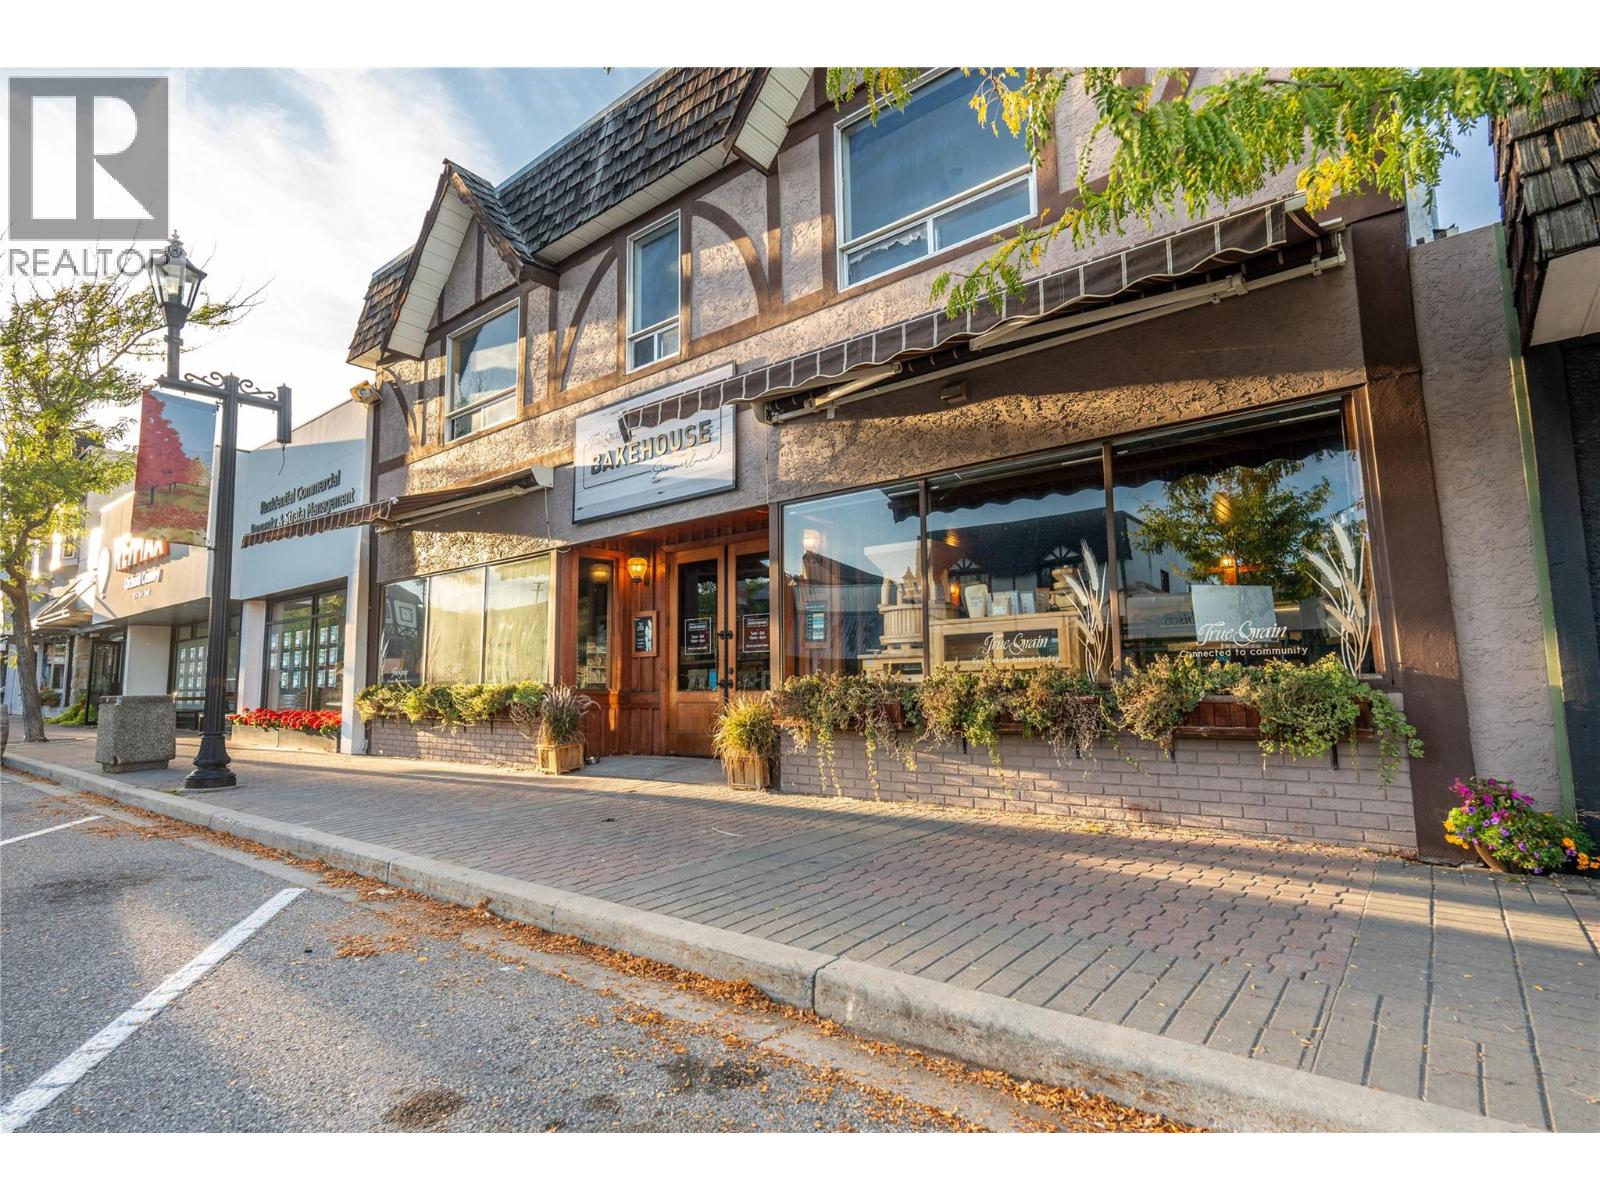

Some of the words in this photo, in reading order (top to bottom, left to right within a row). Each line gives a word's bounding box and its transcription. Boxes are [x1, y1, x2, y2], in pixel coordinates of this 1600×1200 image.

[591, 419, 711, 475] BAKEHOUSE
[260, 487, 296, 515] Residential
[297, 469, 341, 501] Commercial
[285, 507, 306, 526] Strata
[307, 487, 355, 518] Management
[982, 634, 1010, 654] True
[1009, 632, 1048, 655] Grain
[1195, 621, 1233, 646] True
[1232, 620, 1287, 646] Grain
[1235, 649, 1246, 657] to
[1249, 646, 1308, 657] community
